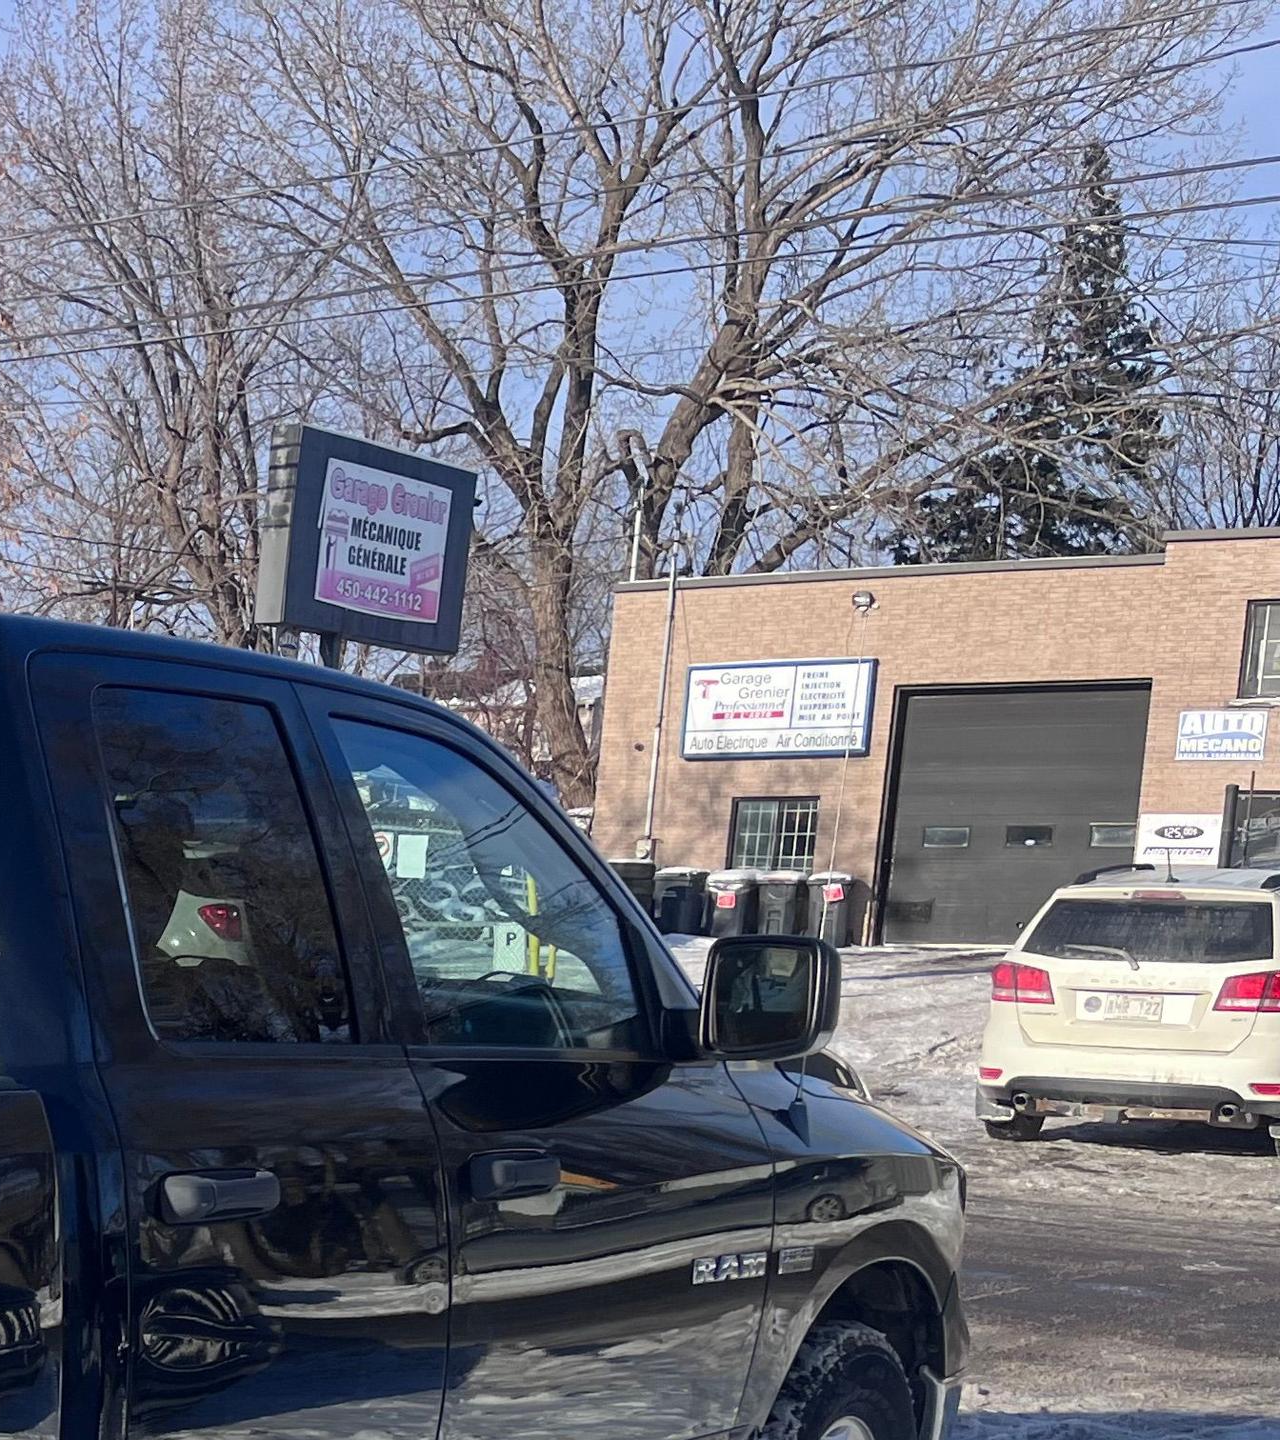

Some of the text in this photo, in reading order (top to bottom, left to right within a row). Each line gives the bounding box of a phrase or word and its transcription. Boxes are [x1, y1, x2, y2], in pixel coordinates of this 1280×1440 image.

[330, 467, 389, 515] Garage
[350, 516, 422, 552] MÉCANIQUE
[347, 543, 407, 576] GÉNÉRALE
[336, 578, 422, 612] 450-442-1112
[720, 672, 772, 687] Garage
[738, 686, 790, 700] Grenier
[713, 699, 786, 711] Professionnel
[1180, 713, 1264, 735] AUTO
[689, 735, 714, 750] Auto
[776, 733, 792, 748] Air
[1179, 738, 1262, 752] MECANO
[505, 932, 517, 946] P
[692, 1251, 767, 1285] RAM
